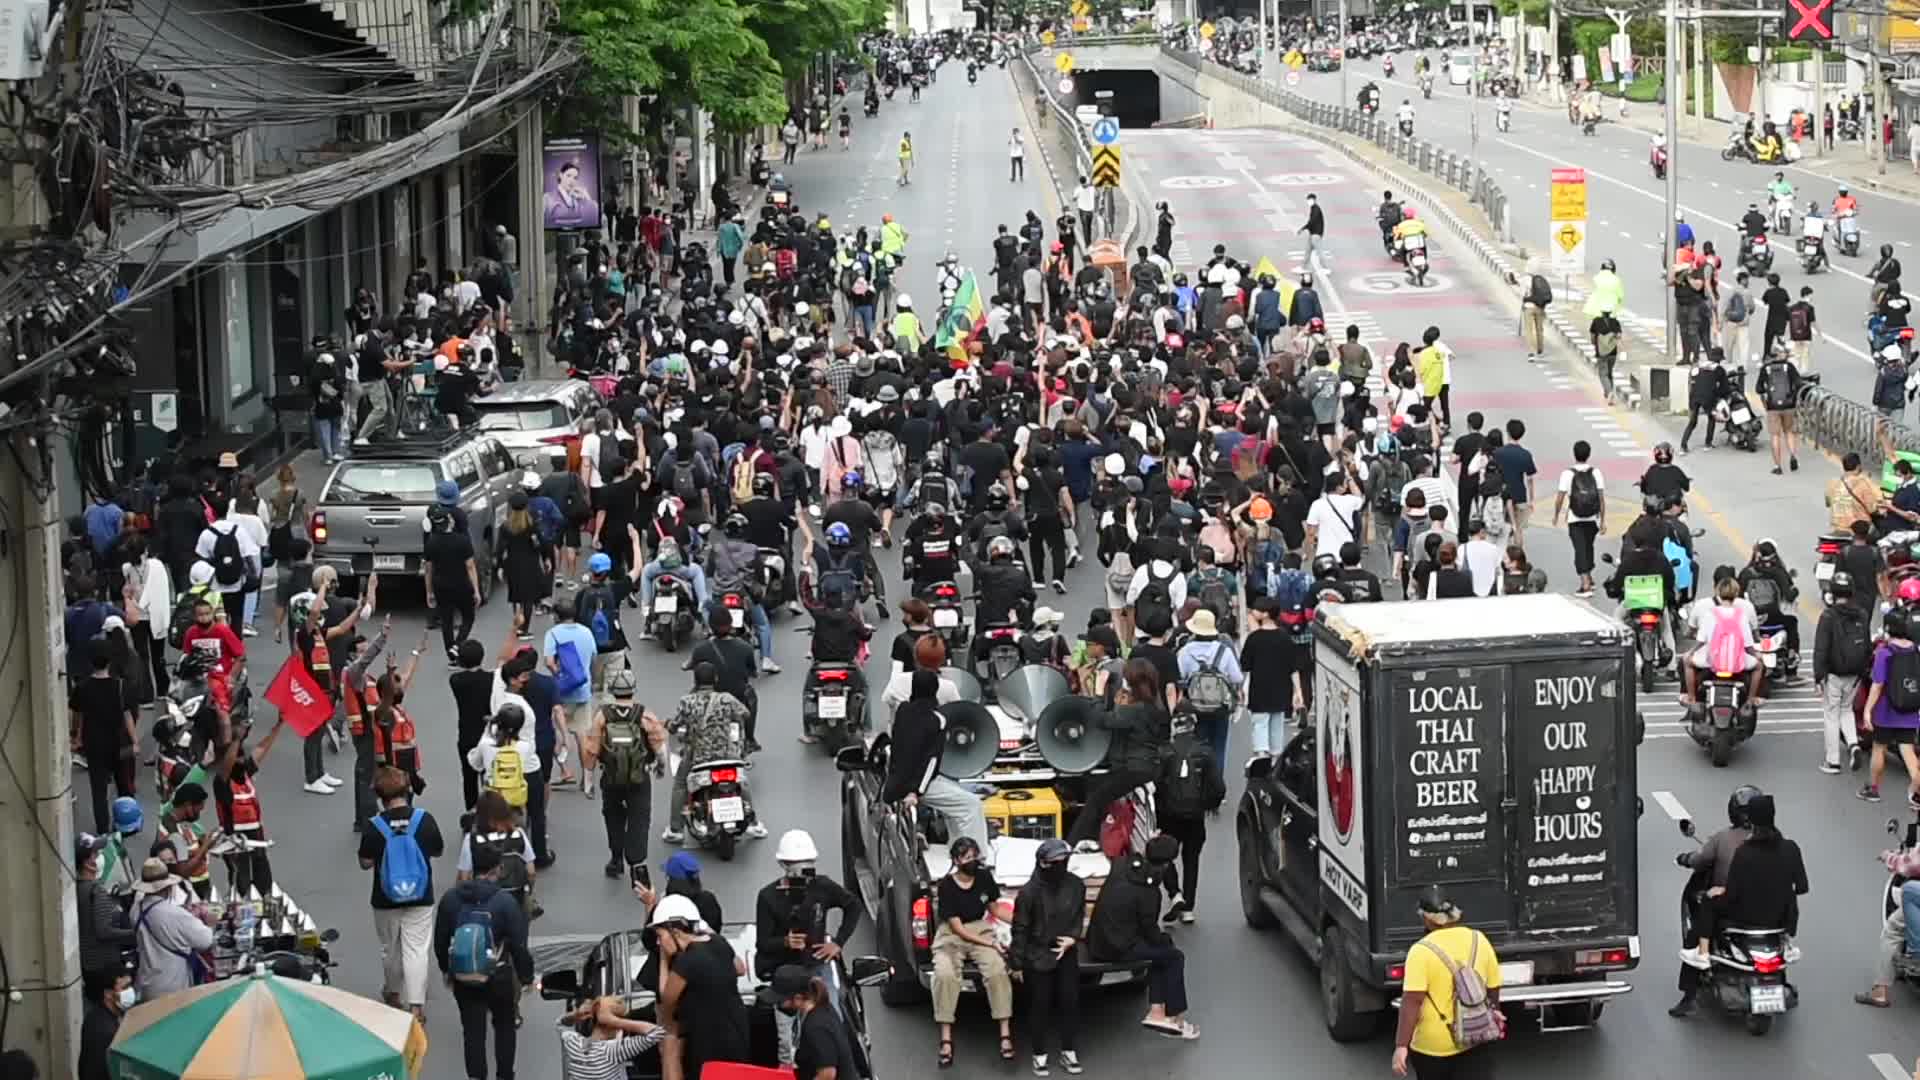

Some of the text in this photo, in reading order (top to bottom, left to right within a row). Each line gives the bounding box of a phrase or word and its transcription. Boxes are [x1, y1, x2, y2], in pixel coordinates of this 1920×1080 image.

[1408, 685, 1483, 713] LOCAL
[1534, 676, 1597, 710] ENJOY
[1416, 717, 1474, 745] THAI
[1544, 721, 1588, 751] OUR
[1409, 747, 1482, 776] CRAFT
[1415, 779, 1479, 808] BEER
[1540, 765, 1597, 795] HAPPY
[1534, 811, 1602, 843] HOURS
